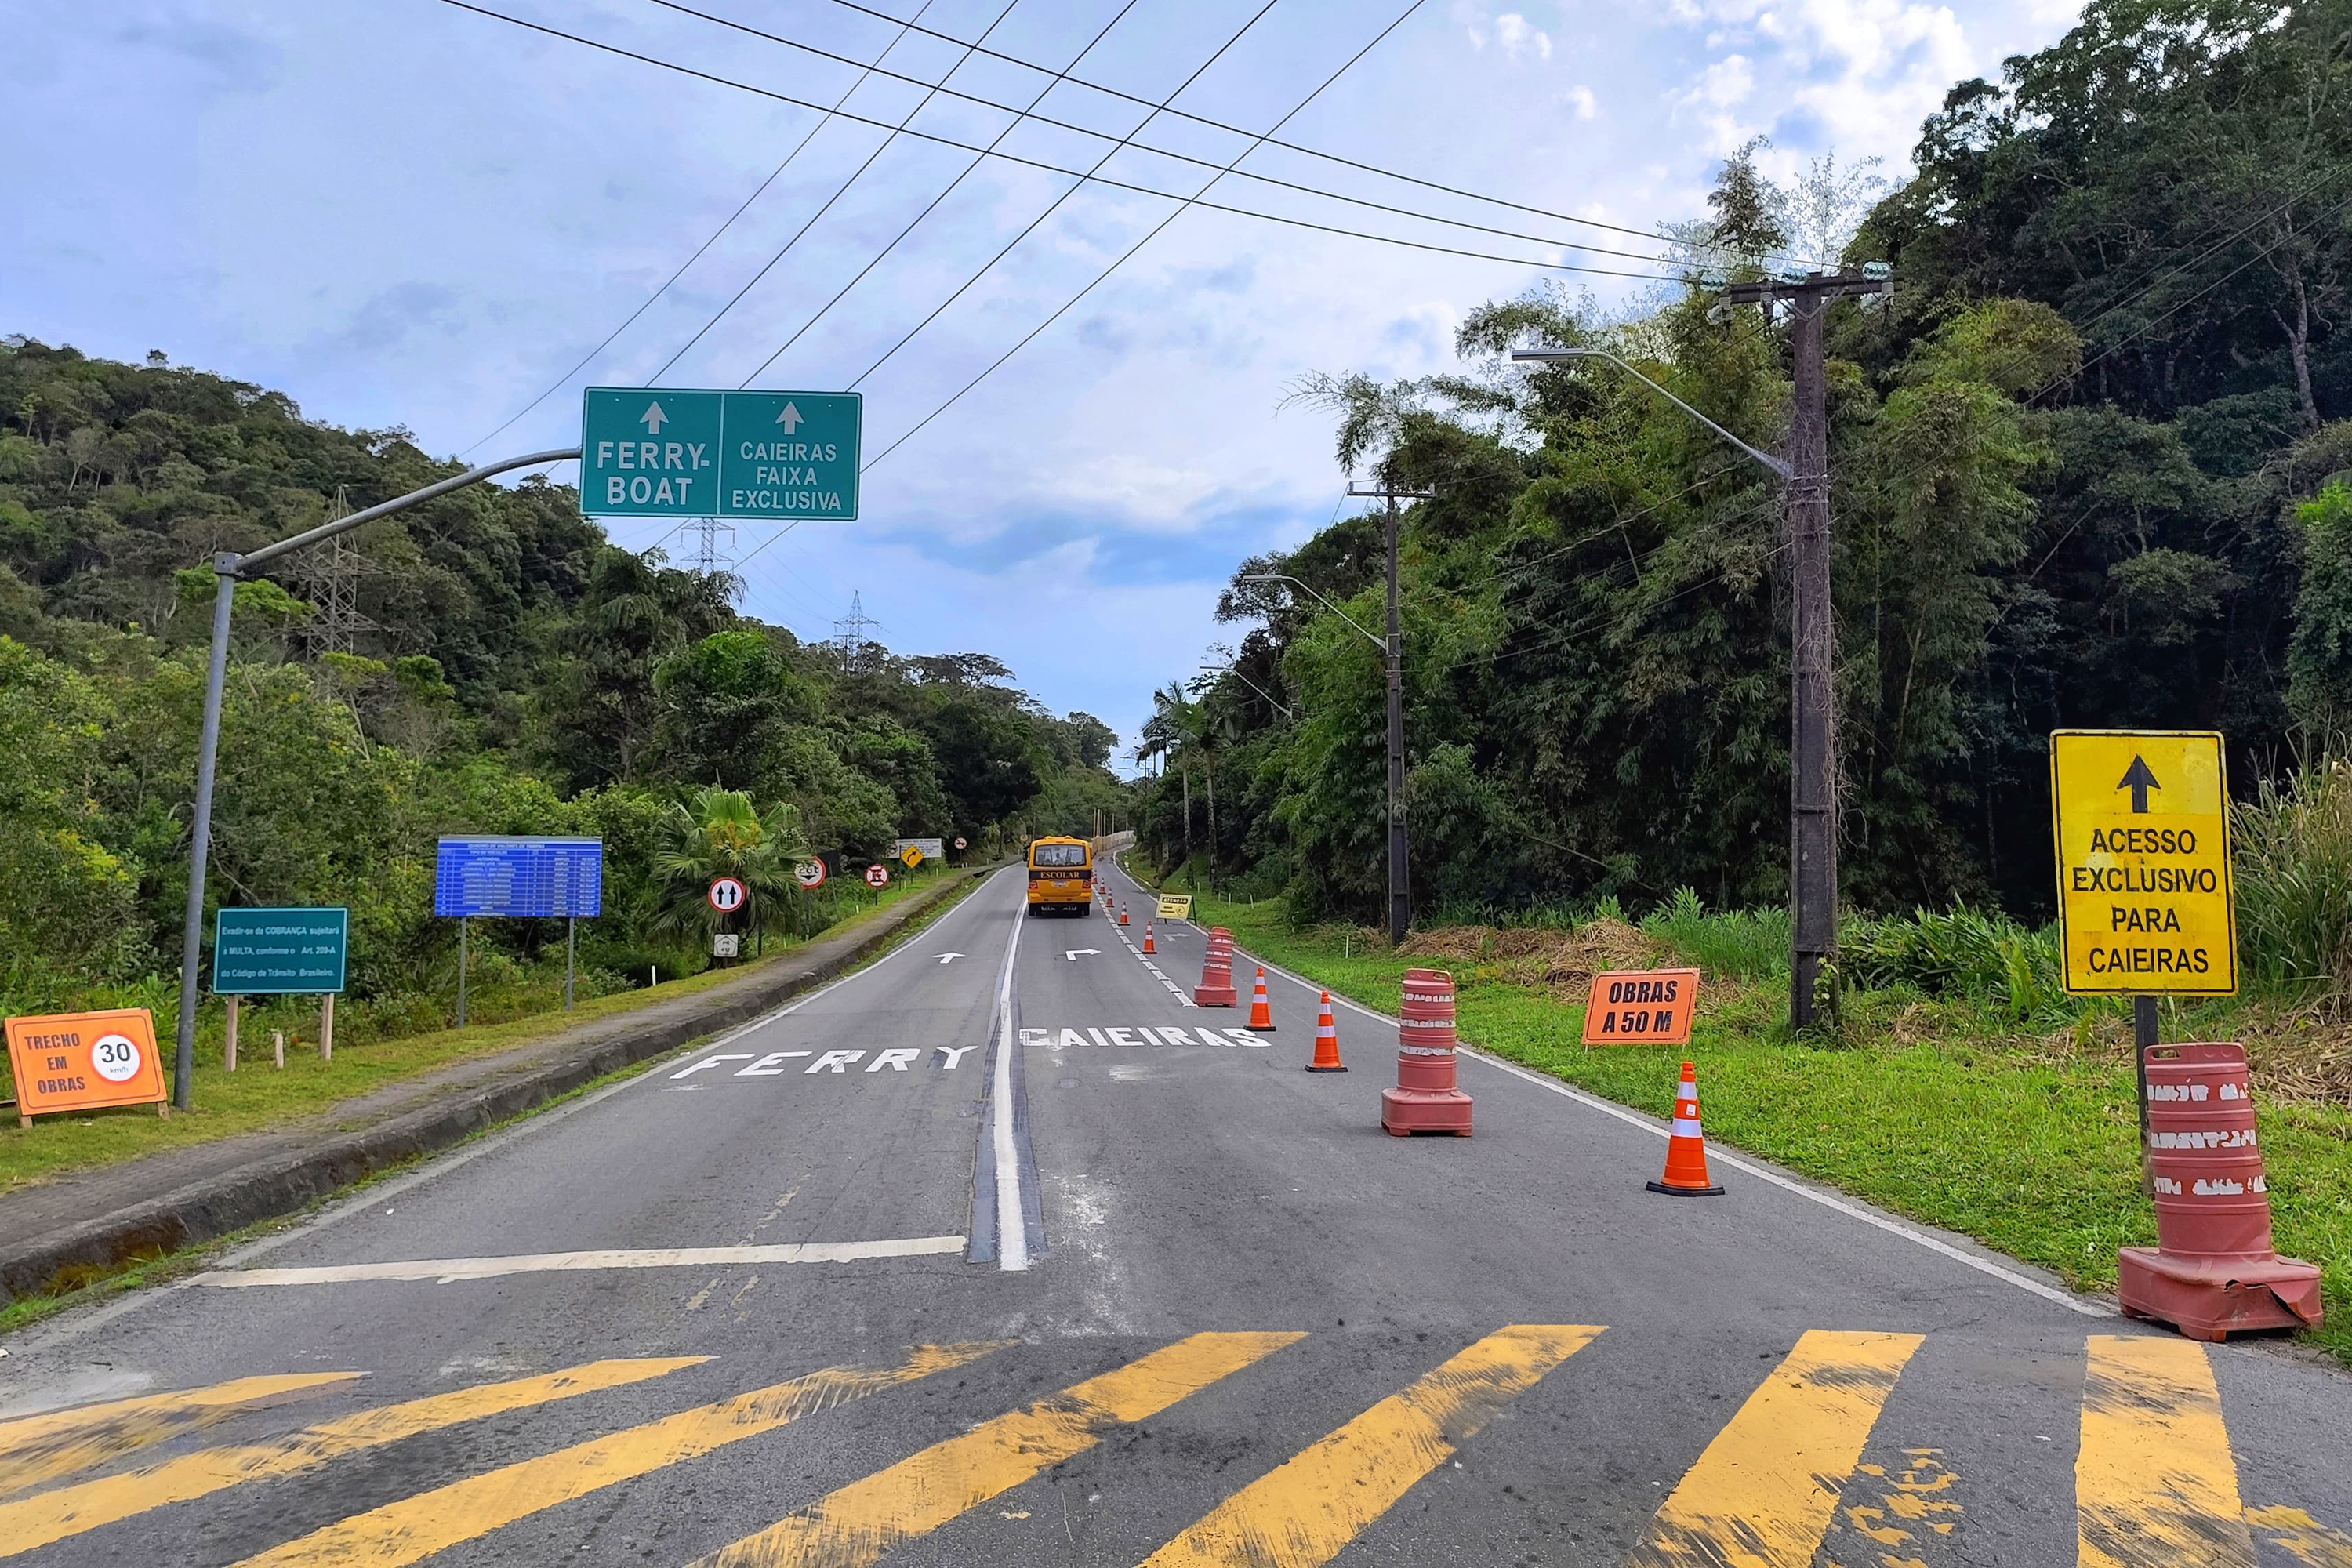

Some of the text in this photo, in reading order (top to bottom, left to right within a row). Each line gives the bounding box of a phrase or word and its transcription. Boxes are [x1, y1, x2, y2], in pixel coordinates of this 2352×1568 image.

[597, 441, 710, 470] FERRY-
[740, 441, 837, 463] CAIEIRAS
[757, 466, 817, 485] FAIXA
[607, 476, 693, 506] BOAT
[732, 490, 841, 510] EXCLUSIVA
[2090, 828, 2196, 854] ACESSO
[2072, 867, 2216, 893] EXCLUSIVO
[2112, 907, 2180, 933] PARA
[222, 927, 254, 935] Evadir-se
[265, 927, 307, 936] COBRANÇA
[310, 927, 340, 936] sujeitará
[256, 947, 289, 955] conforme
[301, 946, 314, 955] Art.
[2089, 947, 2209, 974] CAIEIRAS
[231, 969, 257, 979] Código
[267, 969, 296, 977] Trânsito
[299, 968, 335, 977] Brasileiro.
[1609, 980, 1678, 1004] OBRAS
[1602, 1011, 1673, 1033] A 50 M
[24, 1033, 81, 1051] TRECHO
[1019, 1027, 1272, 1047] CAIEIRAS
[100, 1043, 131, 1063] 30
[670, 1045, 978, 1080] FERRY
[47, 1056, 67, 1071] EM
[110, 1066, 129, 1074] km/h
[37, 1076, 85, 1094] OBRAS
